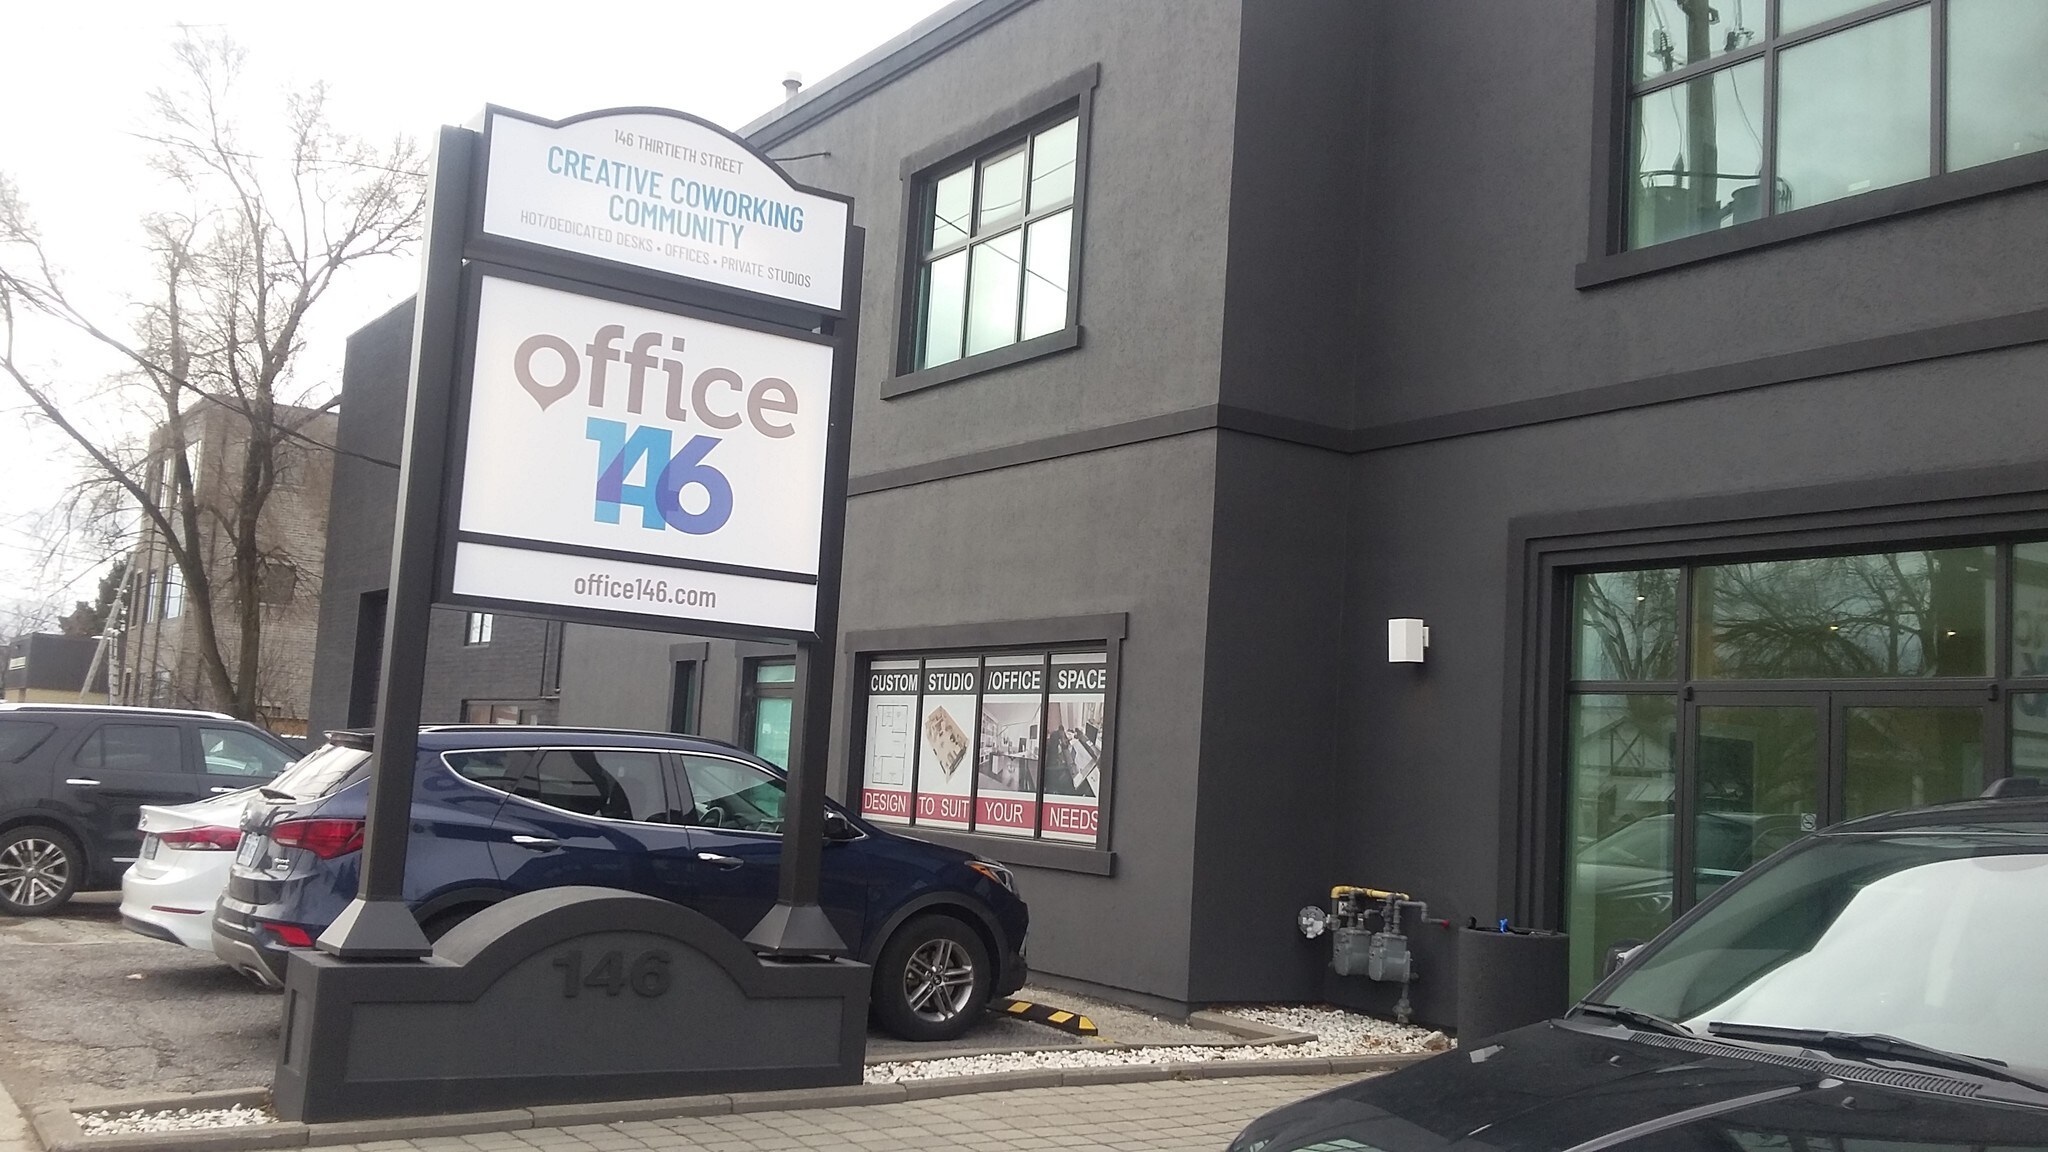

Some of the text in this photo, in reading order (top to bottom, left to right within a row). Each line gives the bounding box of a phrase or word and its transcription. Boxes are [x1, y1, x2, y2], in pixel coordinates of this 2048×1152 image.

[614, 129, 744, 175] 146 THIRTIETH STREET
[547, 145, 804, 233] CREATIVE COWORKING
[520, 209, 811, 288] HOT/DEDICATED DESKS OFFICES PRIVATE STUDIOS
[608, 195, 744, 250] COMMUNITY
[513, 324, 799, 439] office
[585, 416, 734, 536] 146
[574, 573, 717, 609] office146.com
[871, 669, 1107, 692] CUSTOM STUDIO /OFFICE SPACE
[864, 792, 1099, 831] DESIGN TO SUIT YOUR NEEDS
[552, 950, 673, 999] 146
